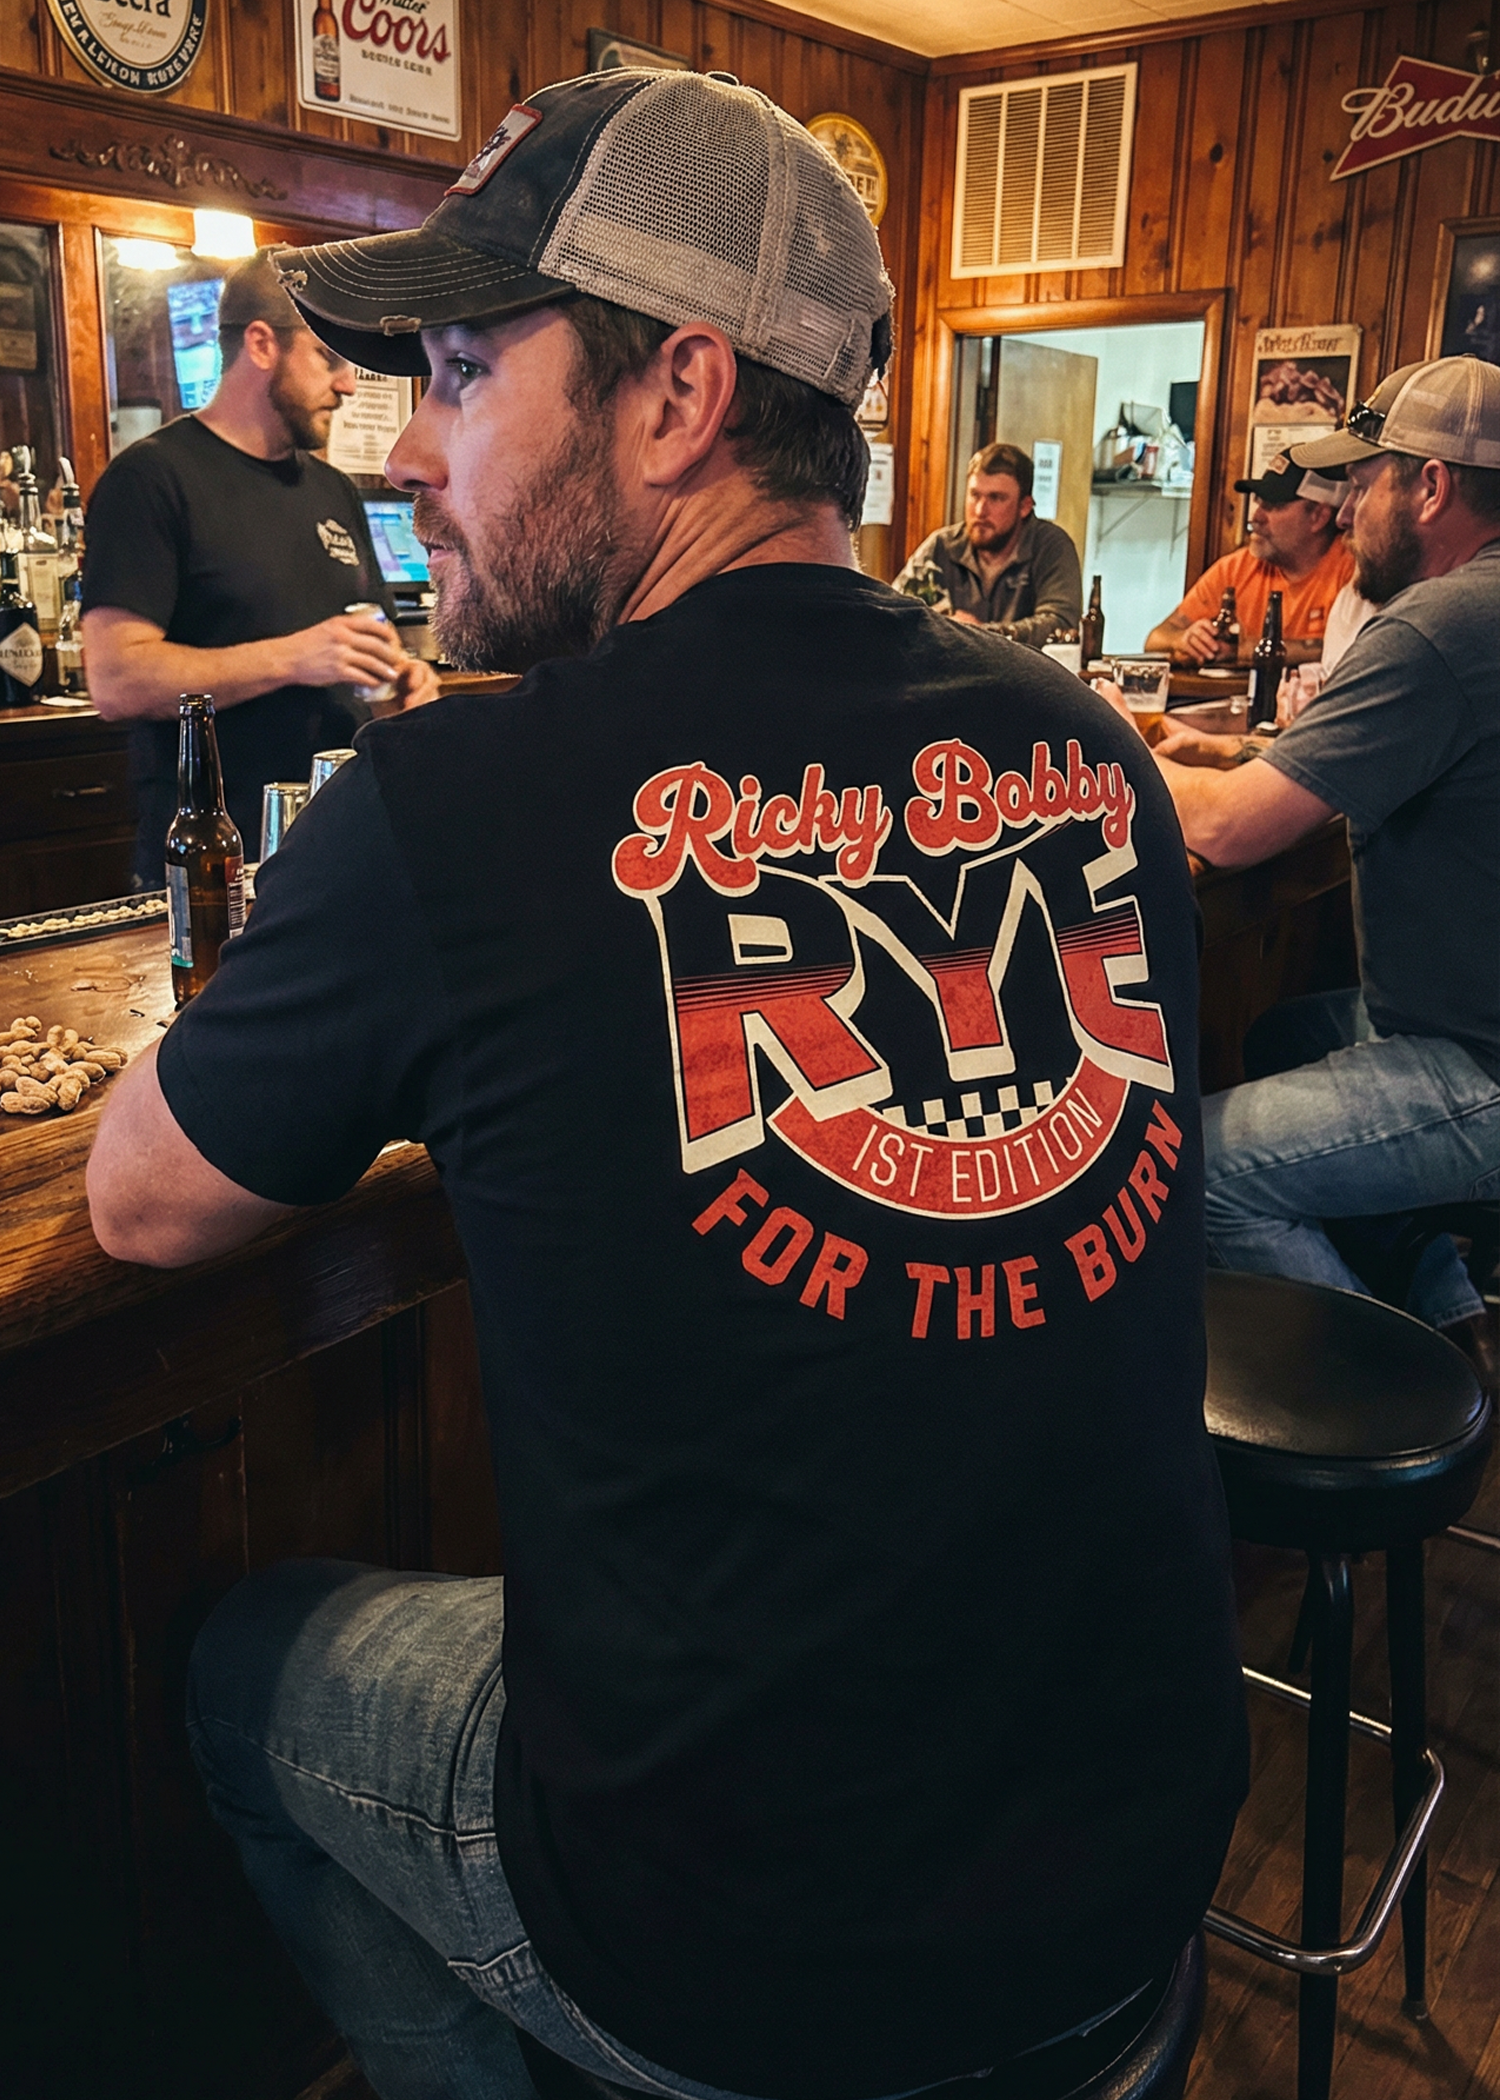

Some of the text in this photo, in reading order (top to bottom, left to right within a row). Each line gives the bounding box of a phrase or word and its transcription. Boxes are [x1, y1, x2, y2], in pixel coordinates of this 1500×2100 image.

[342, 0, 451, 65] Coors
[612, 738, 1136, 898] Ricky Bobby
[648, 822, 1175, 1174] RYE
[691, 1099, 1183, 1340] FOR THE BURN
[952, 1087, 1103, 1203] EDITION
